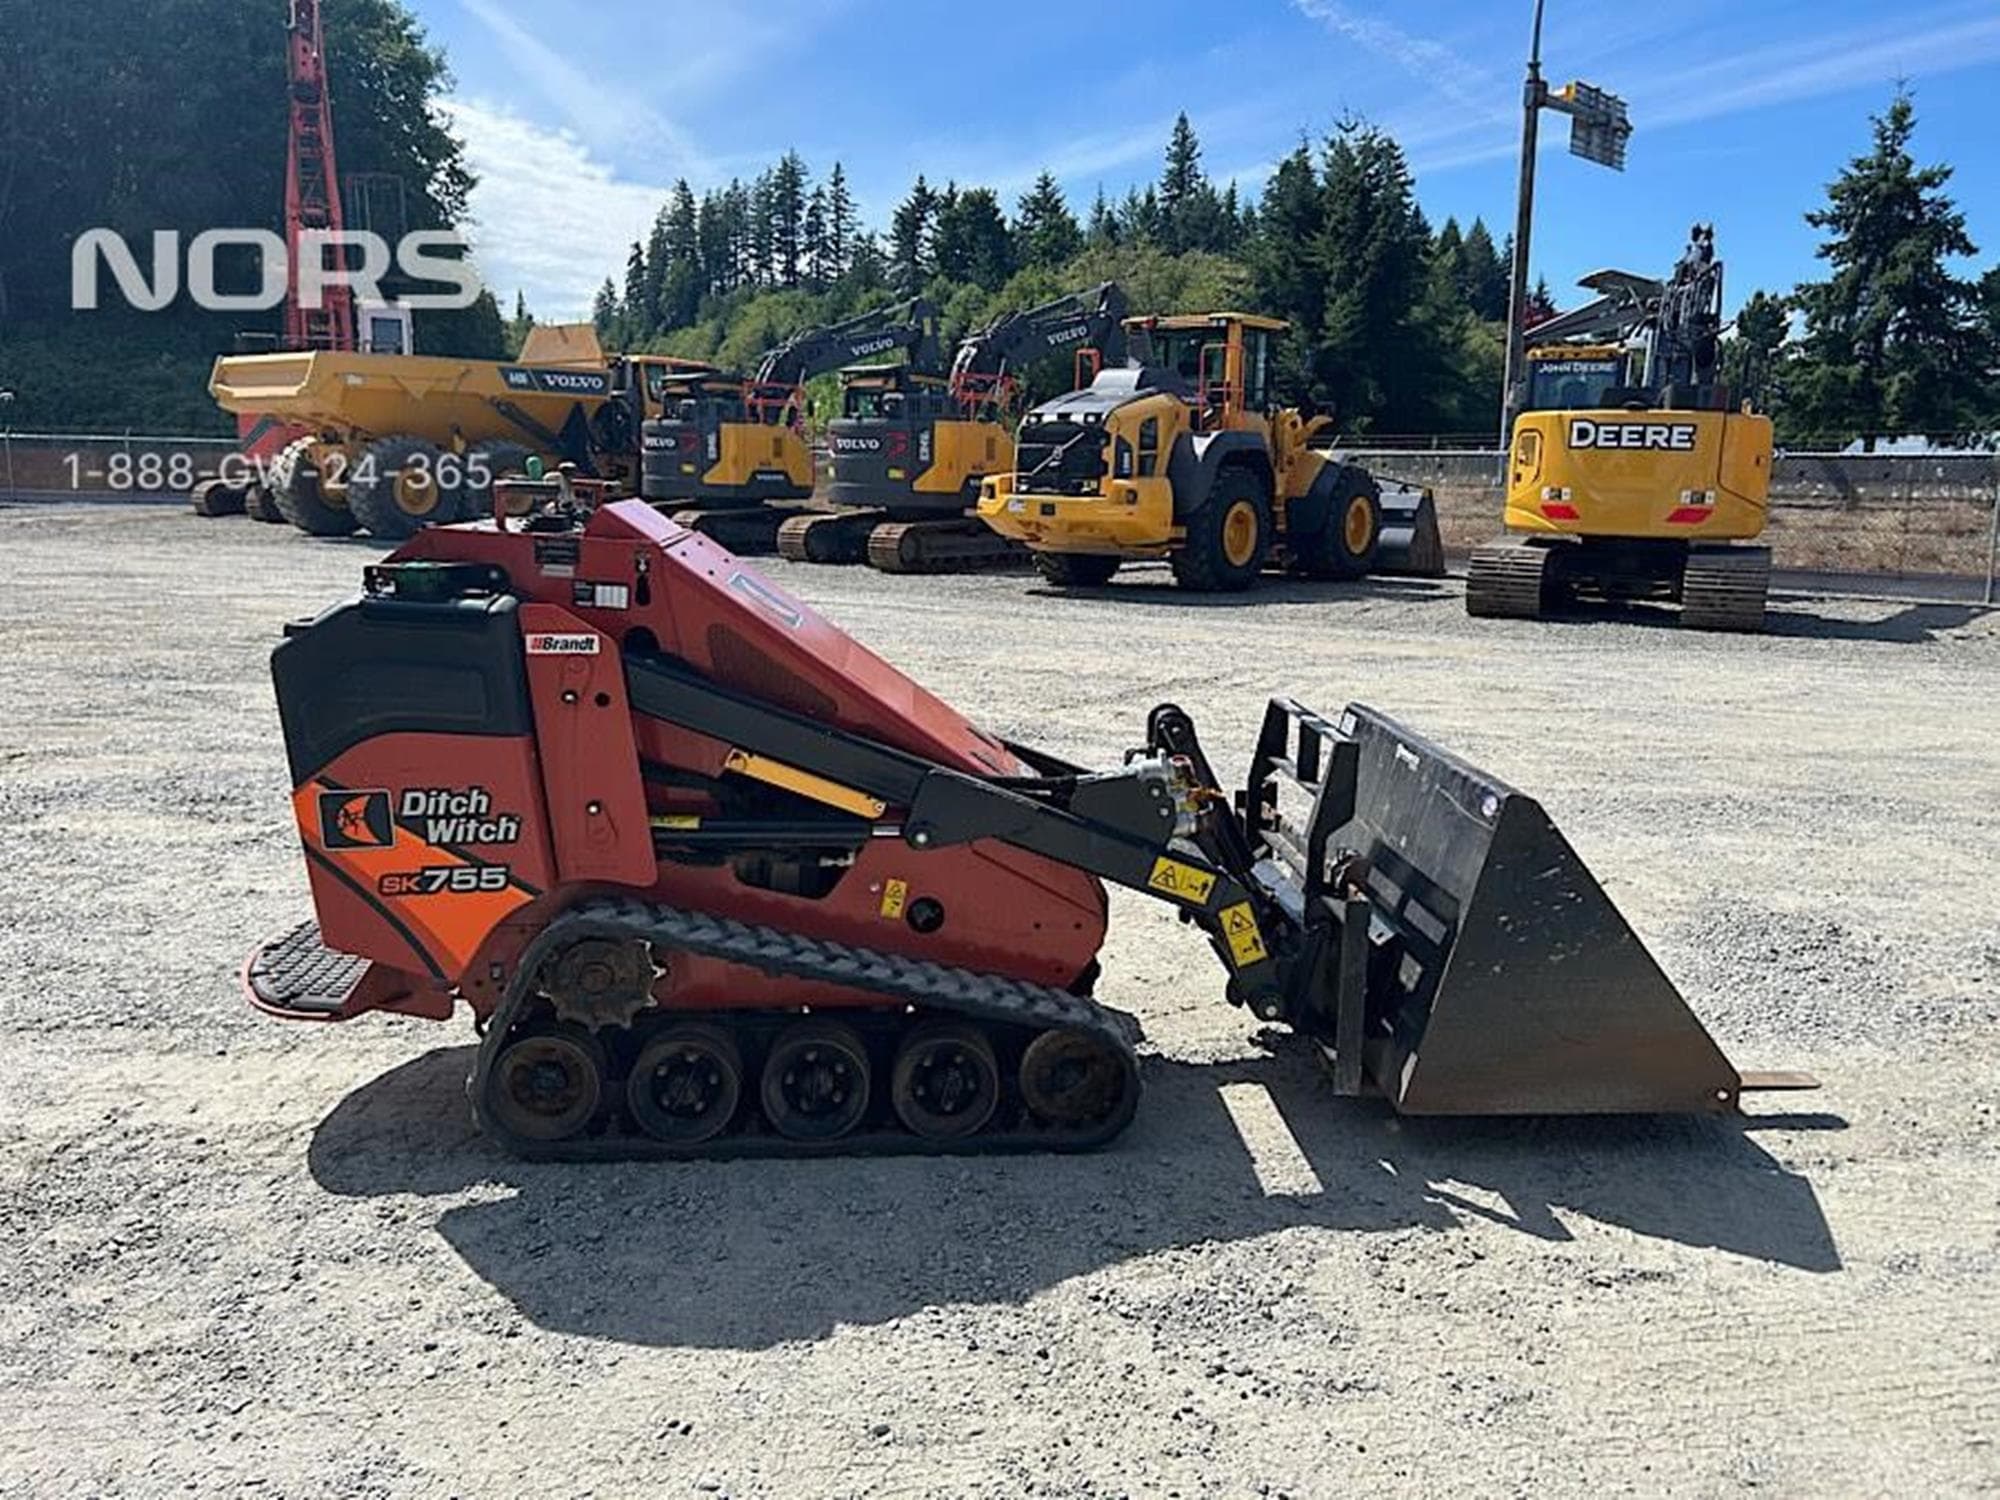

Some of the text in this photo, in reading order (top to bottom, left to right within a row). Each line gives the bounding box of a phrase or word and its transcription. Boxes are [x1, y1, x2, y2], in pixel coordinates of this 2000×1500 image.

[1047, 326, 1087, 345] VOLVO
[850, 337, 894, 356] VOLVO
[1539, 361, 1616, 373] JOHN DEERE
[543, 373, 604, 389] VOLVO
[836, 437, 880, 450] VOLVO
[1570, 420, 1695, 448] DEERE
[542, 637, 596, 652] Brandt
[402, 788, 490, 816] Ditch
[426, 816, 520, 844] Witch
[381, 867, 508, 893] SK755
